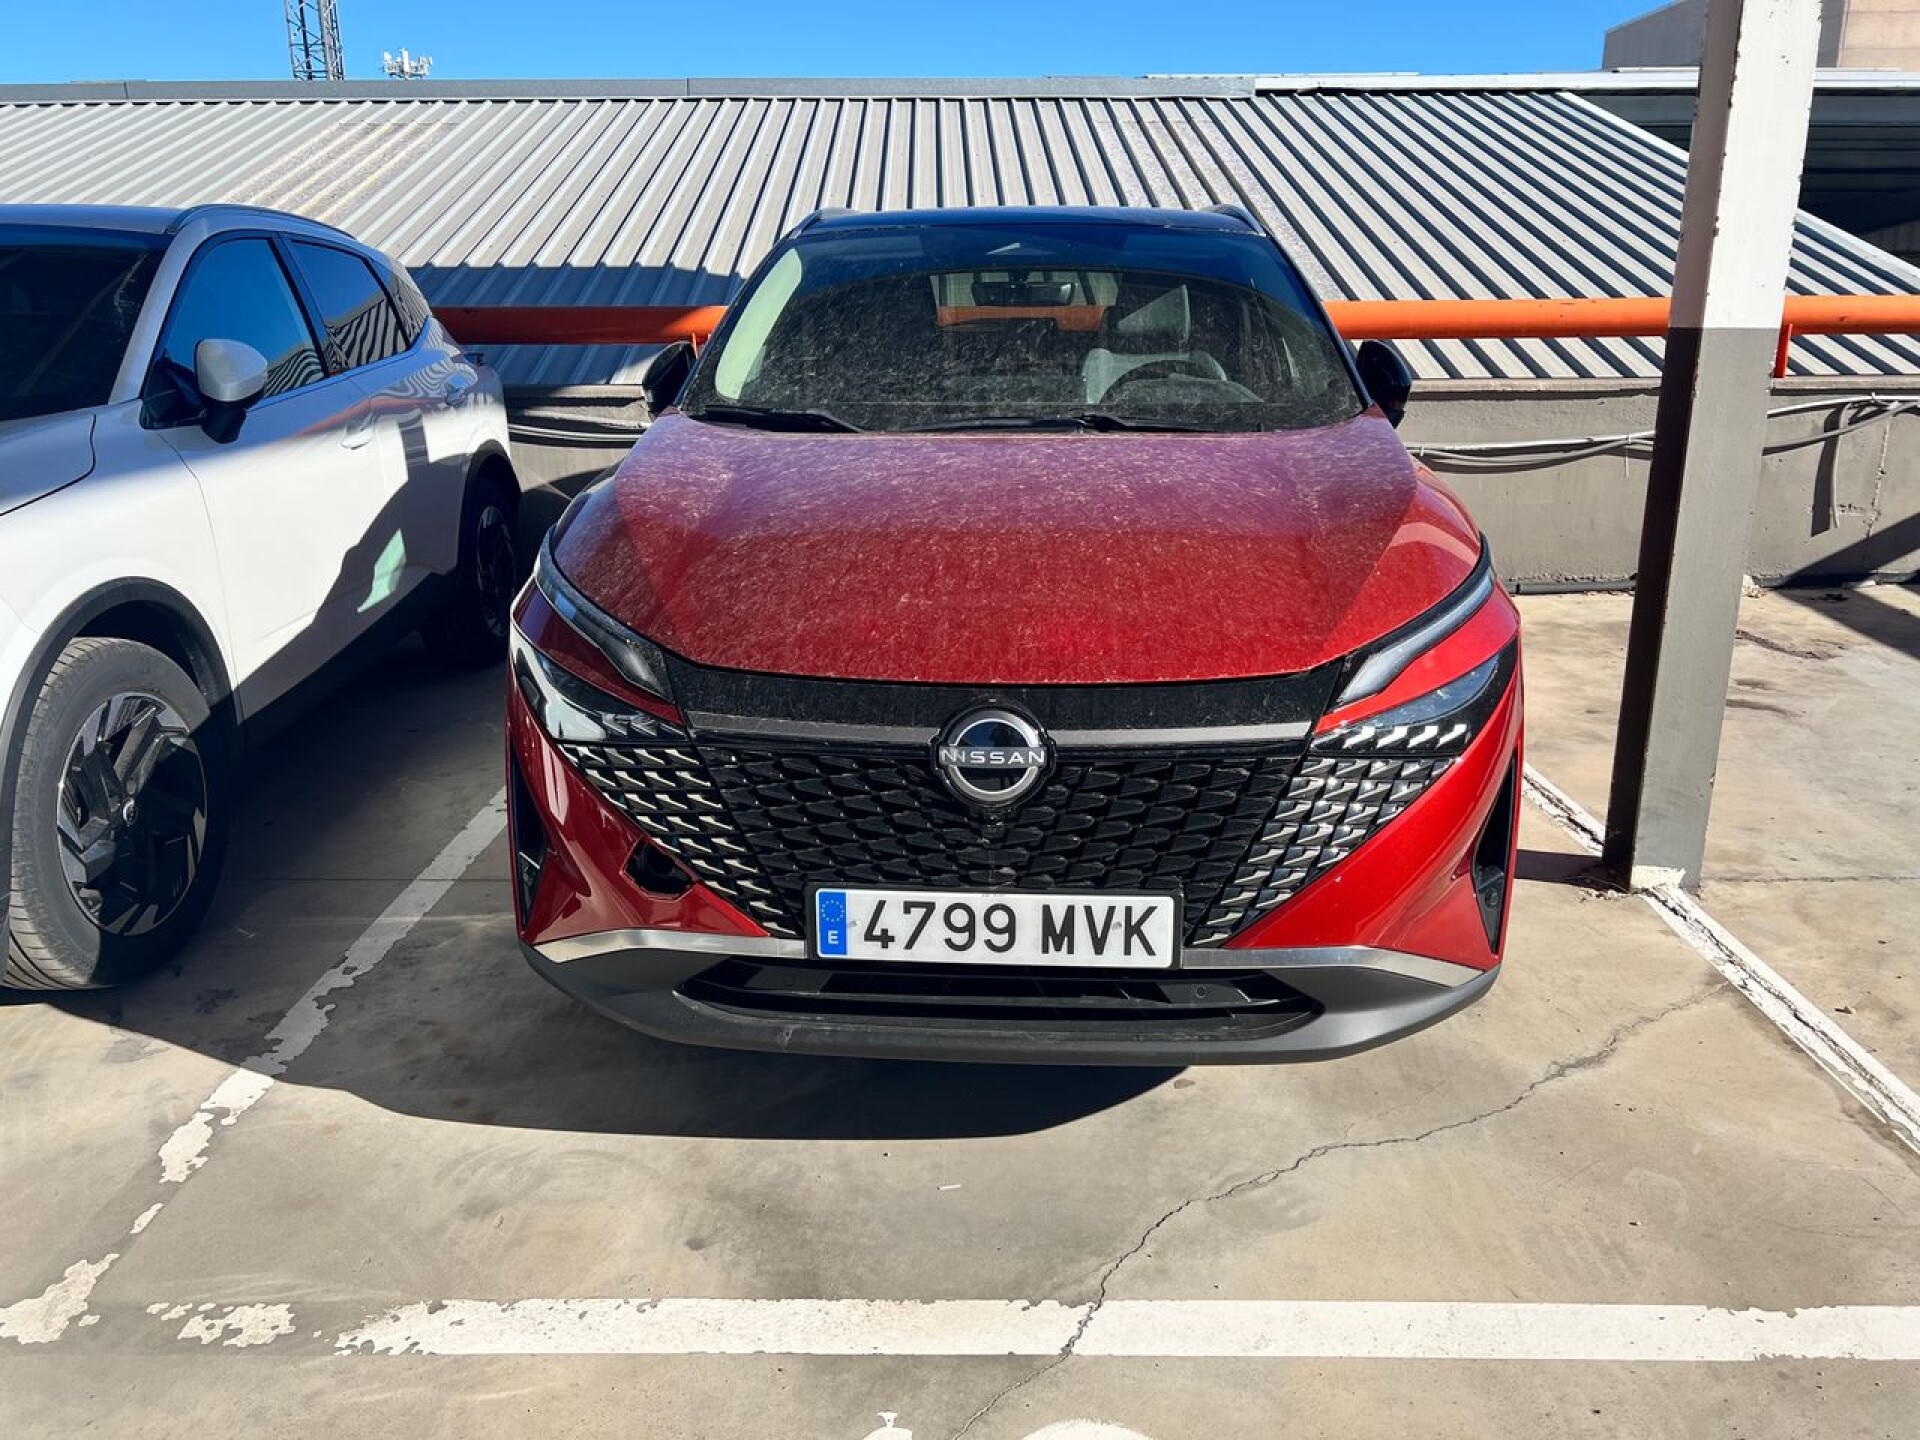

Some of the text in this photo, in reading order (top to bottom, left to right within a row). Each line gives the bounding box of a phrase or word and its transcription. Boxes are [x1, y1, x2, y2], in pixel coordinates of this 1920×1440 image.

[940, 749, 1045, 765] NISSAN
[863, 899, 1158, 956] 4799 MVK
[828, 931, 839, 945] E
